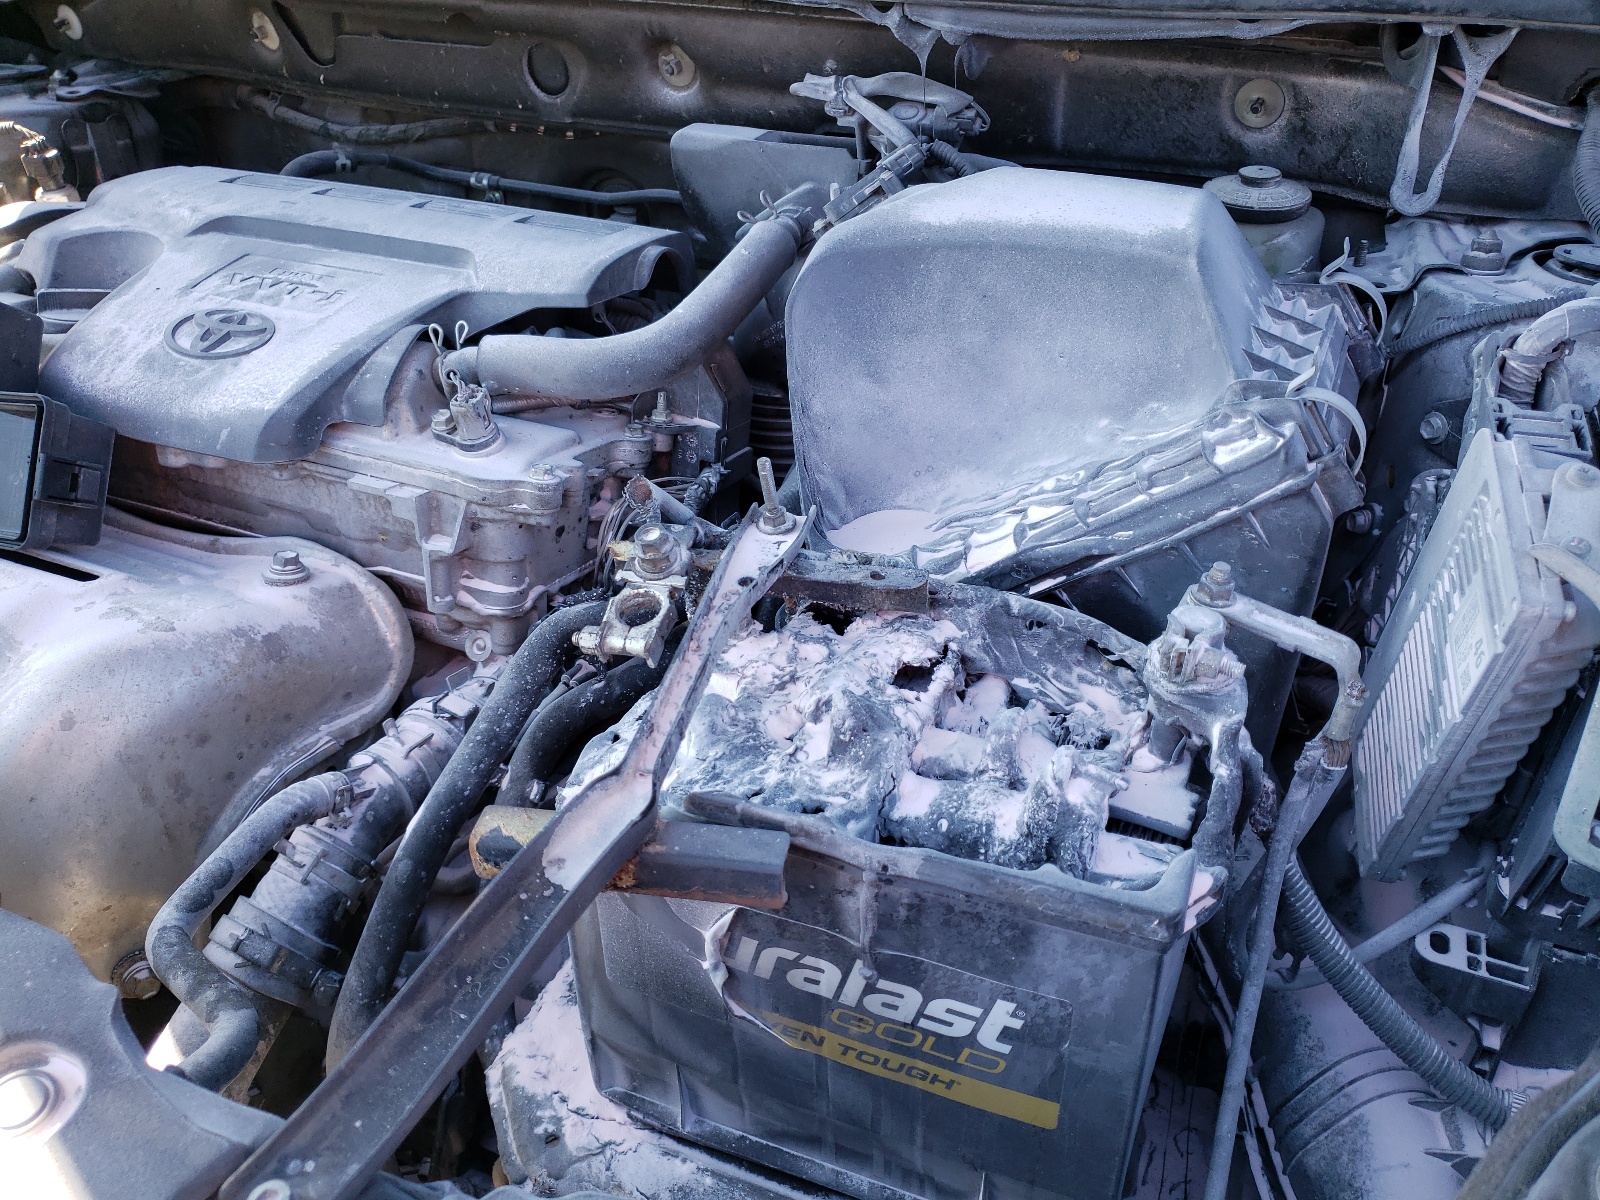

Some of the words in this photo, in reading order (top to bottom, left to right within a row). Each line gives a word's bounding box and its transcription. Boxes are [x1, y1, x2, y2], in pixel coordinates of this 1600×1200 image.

[1472, 637, 1487, 669] 46
[720, 935, 1024, 1055] uralast
[830, 1008, 1007, 1074] GOLD
[837, 1042, 956, 1090] TOUGH
